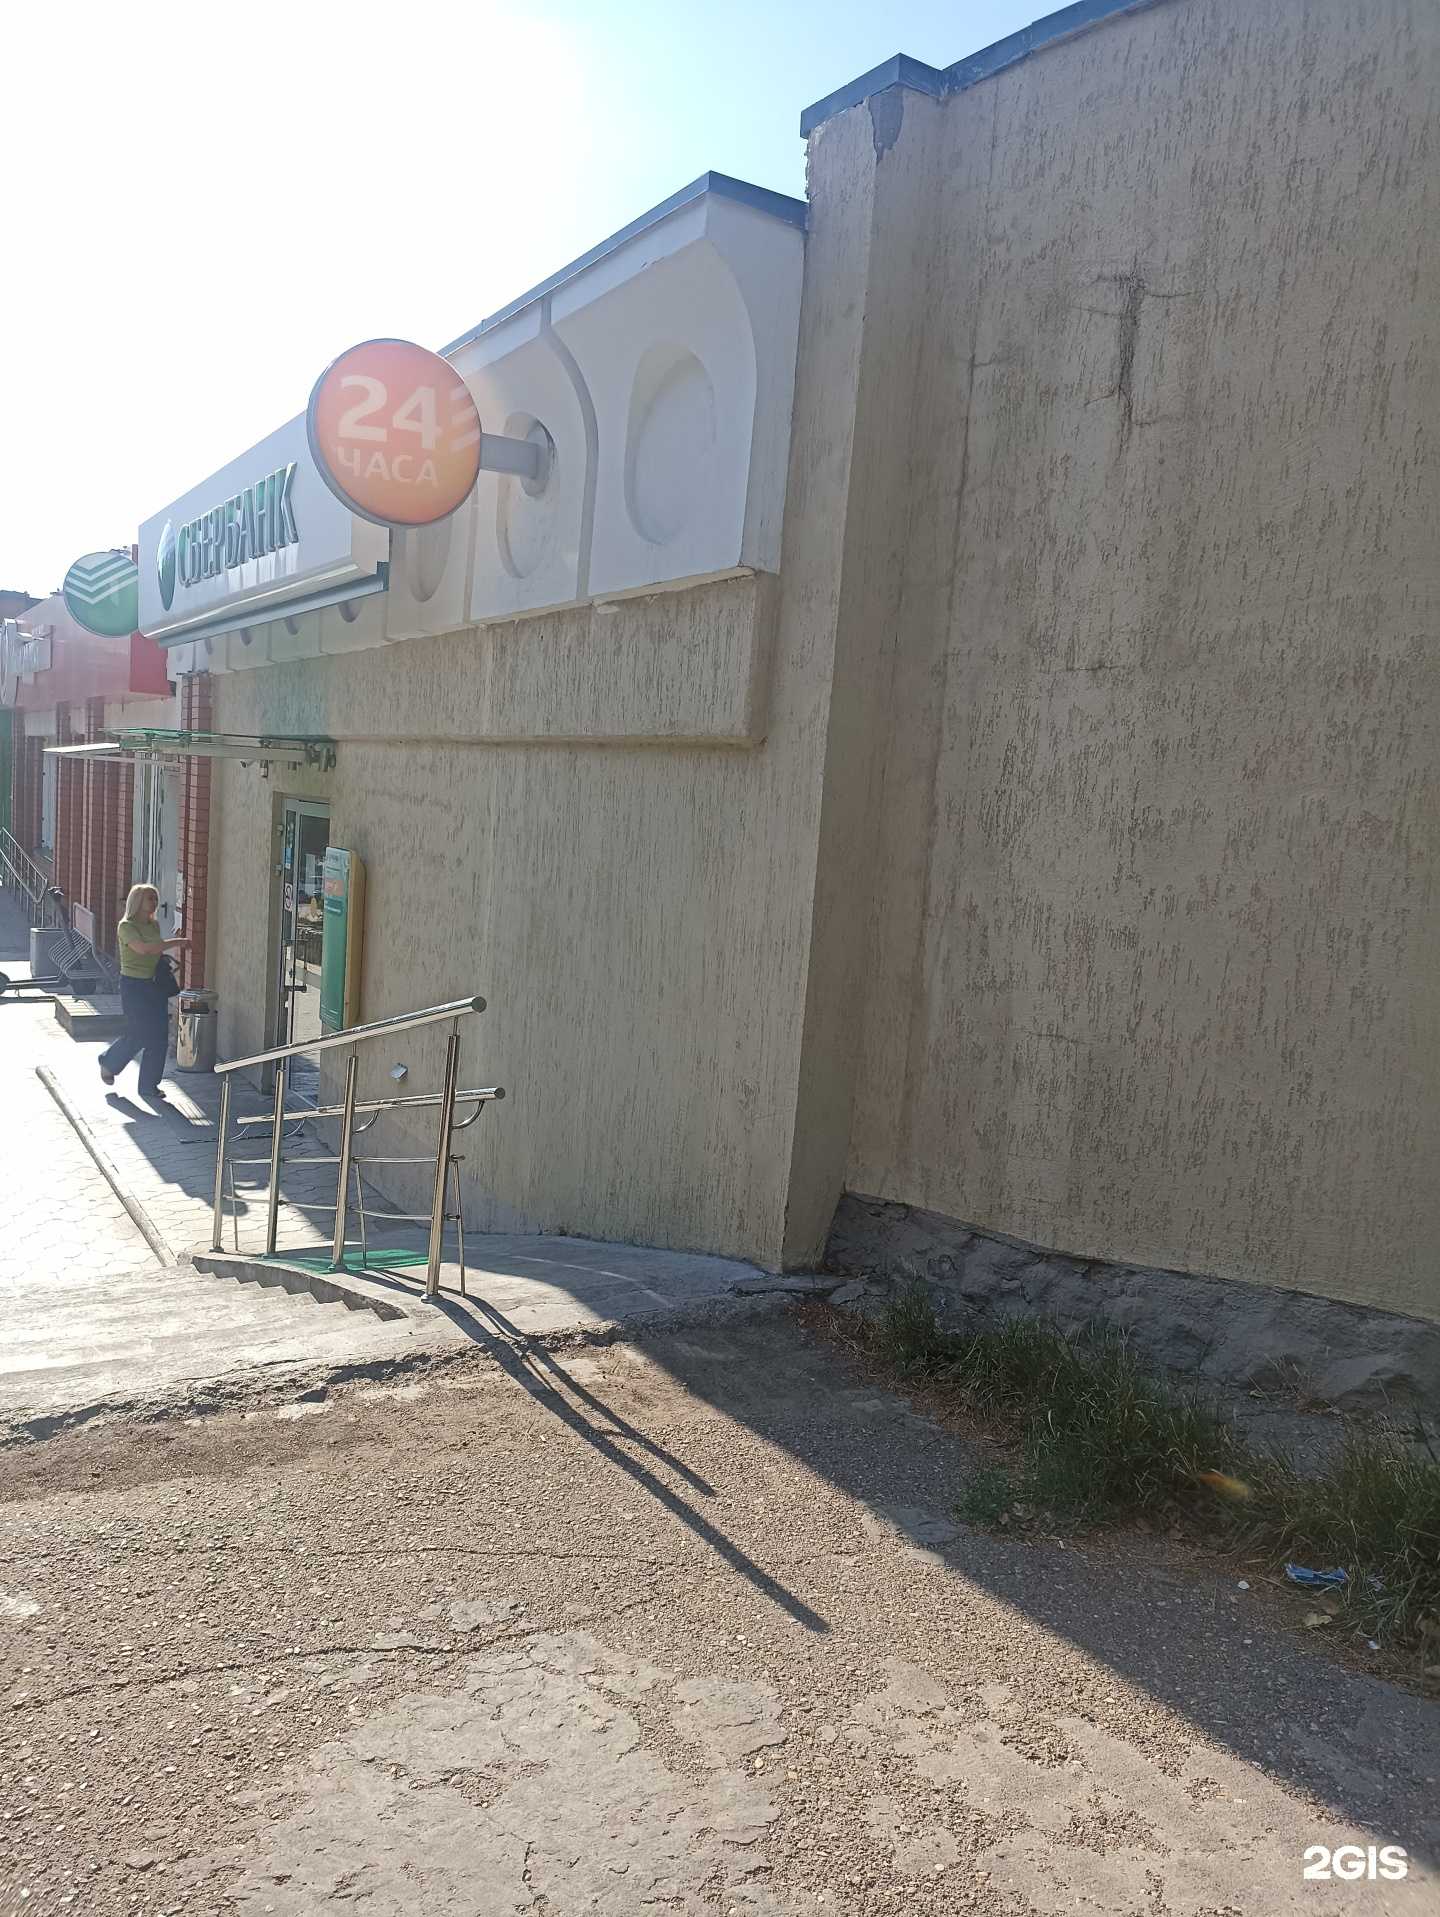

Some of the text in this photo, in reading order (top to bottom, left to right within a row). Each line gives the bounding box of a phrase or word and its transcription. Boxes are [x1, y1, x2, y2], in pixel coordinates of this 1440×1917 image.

[337, 375, 442, 449] 24
[335, 446, 439, 488] ЧАСА
[177, 462, 299, 588] СБЕРБАНК
